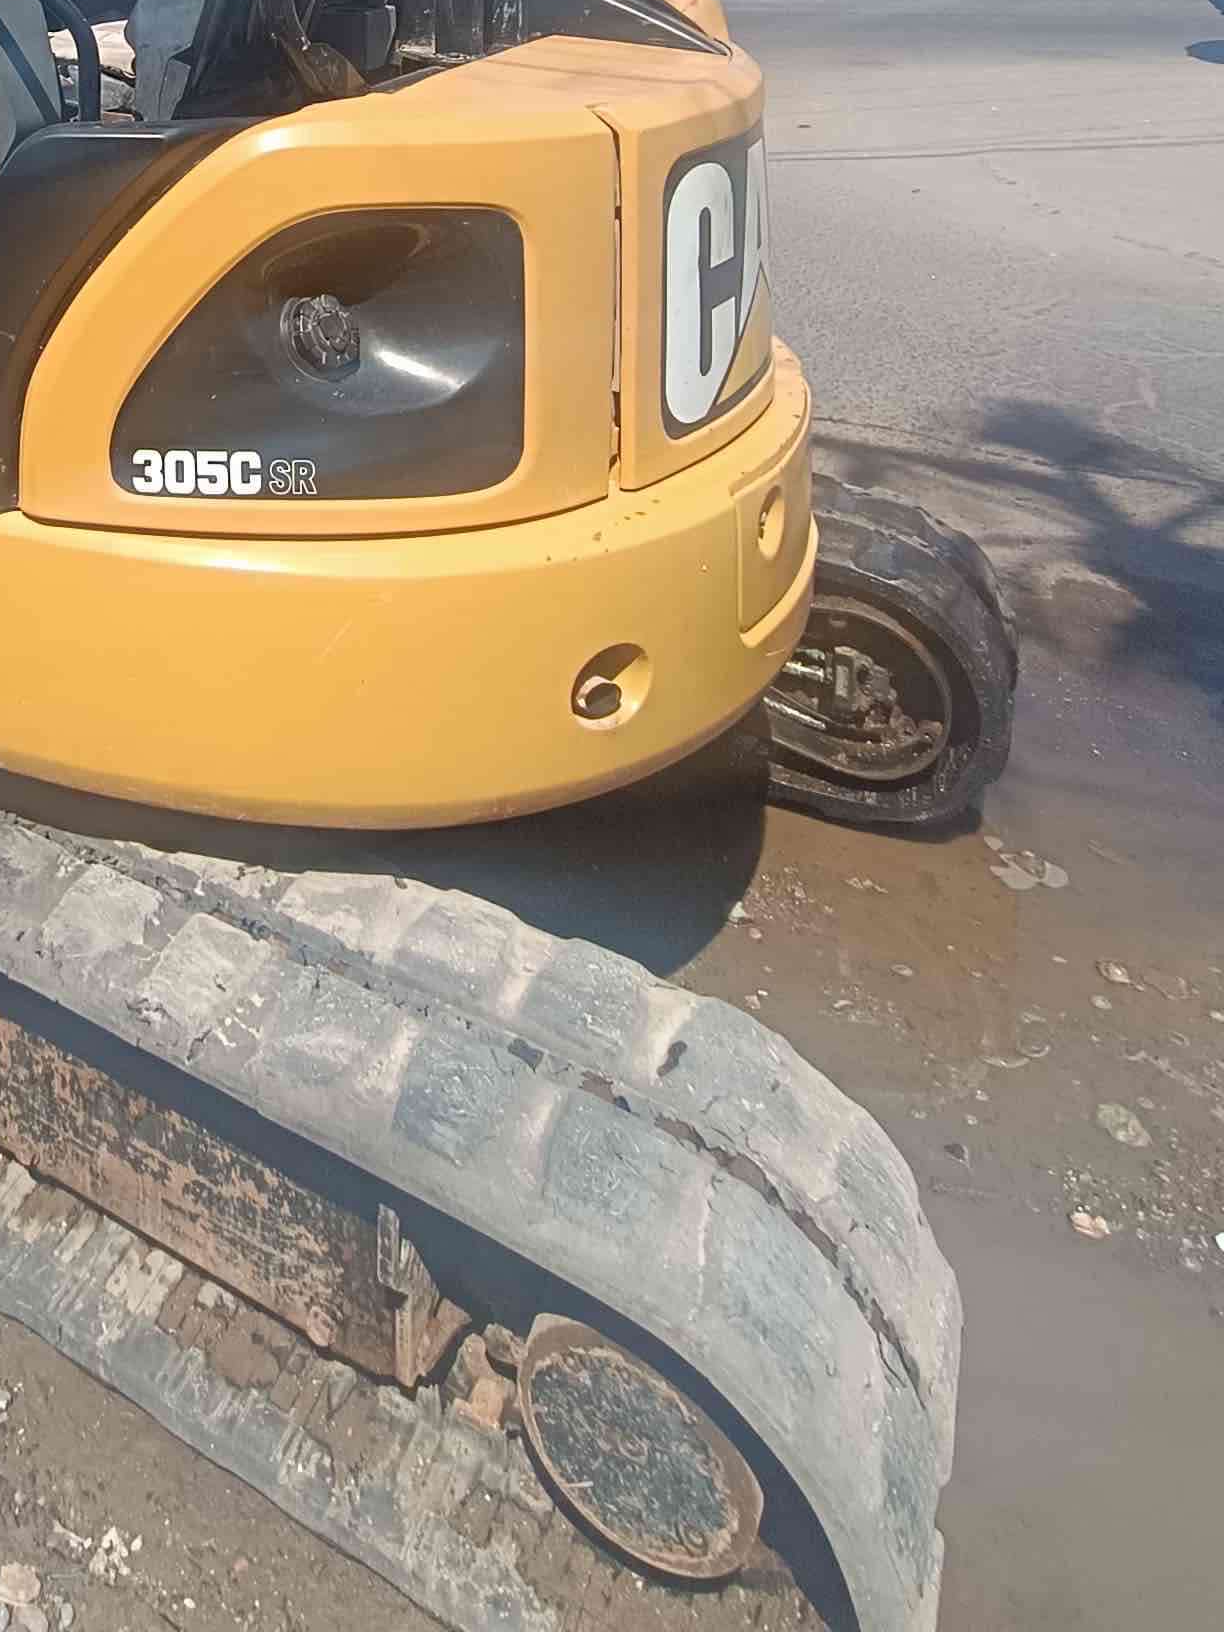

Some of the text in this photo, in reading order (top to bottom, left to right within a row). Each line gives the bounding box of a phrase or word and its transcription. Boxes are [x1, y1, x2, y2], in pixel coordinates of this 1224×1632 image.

[666, 138, 771, 424] CA
[132, 449, 317, 495] 305C SR
